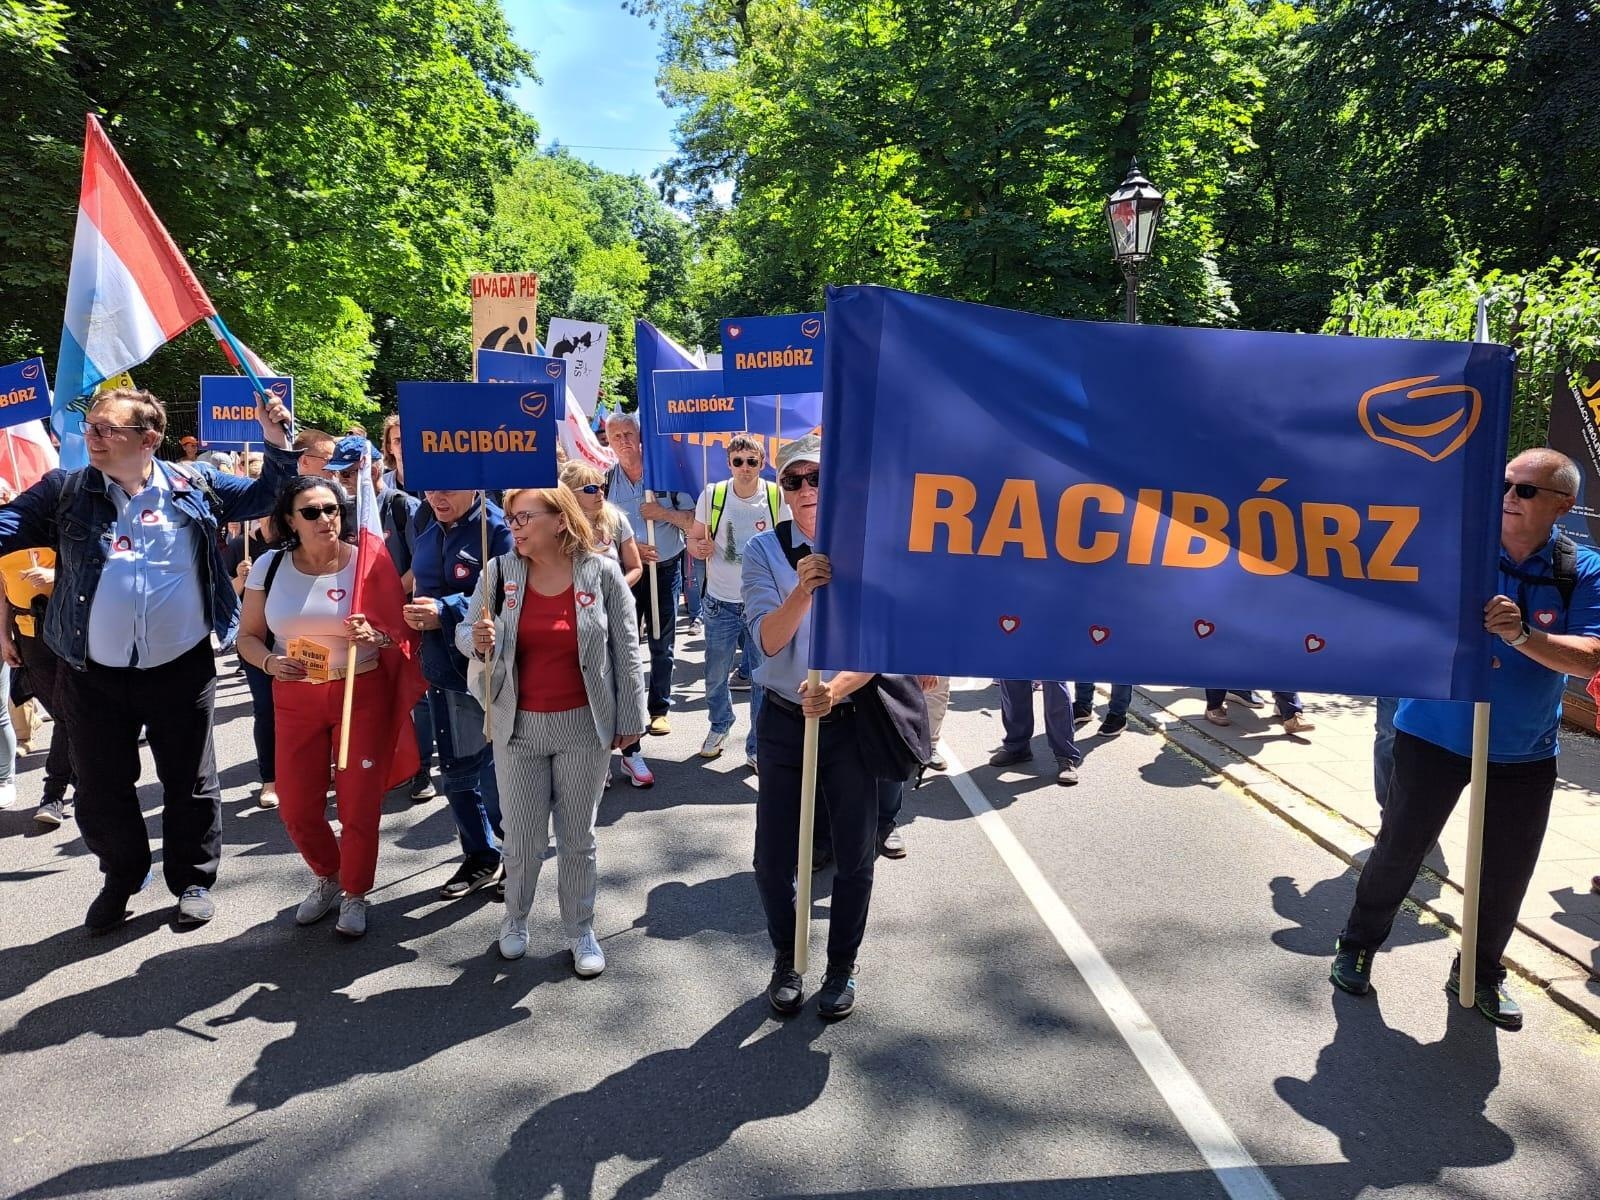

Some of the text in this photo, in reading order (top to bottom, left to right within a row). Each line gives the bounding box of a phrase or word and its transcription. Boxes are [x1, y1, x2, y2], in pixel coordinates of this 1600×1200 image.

[472, 276, 516, 298] UWAGA
[735, 345, 814, 370] RACIBÓRZ
[667, 394, 735, 414] RACIBÓRZ
[421, 424, 537, 452] RACIBÓRZ
[908, 472, 1420, 582] RACIBÓRZ
